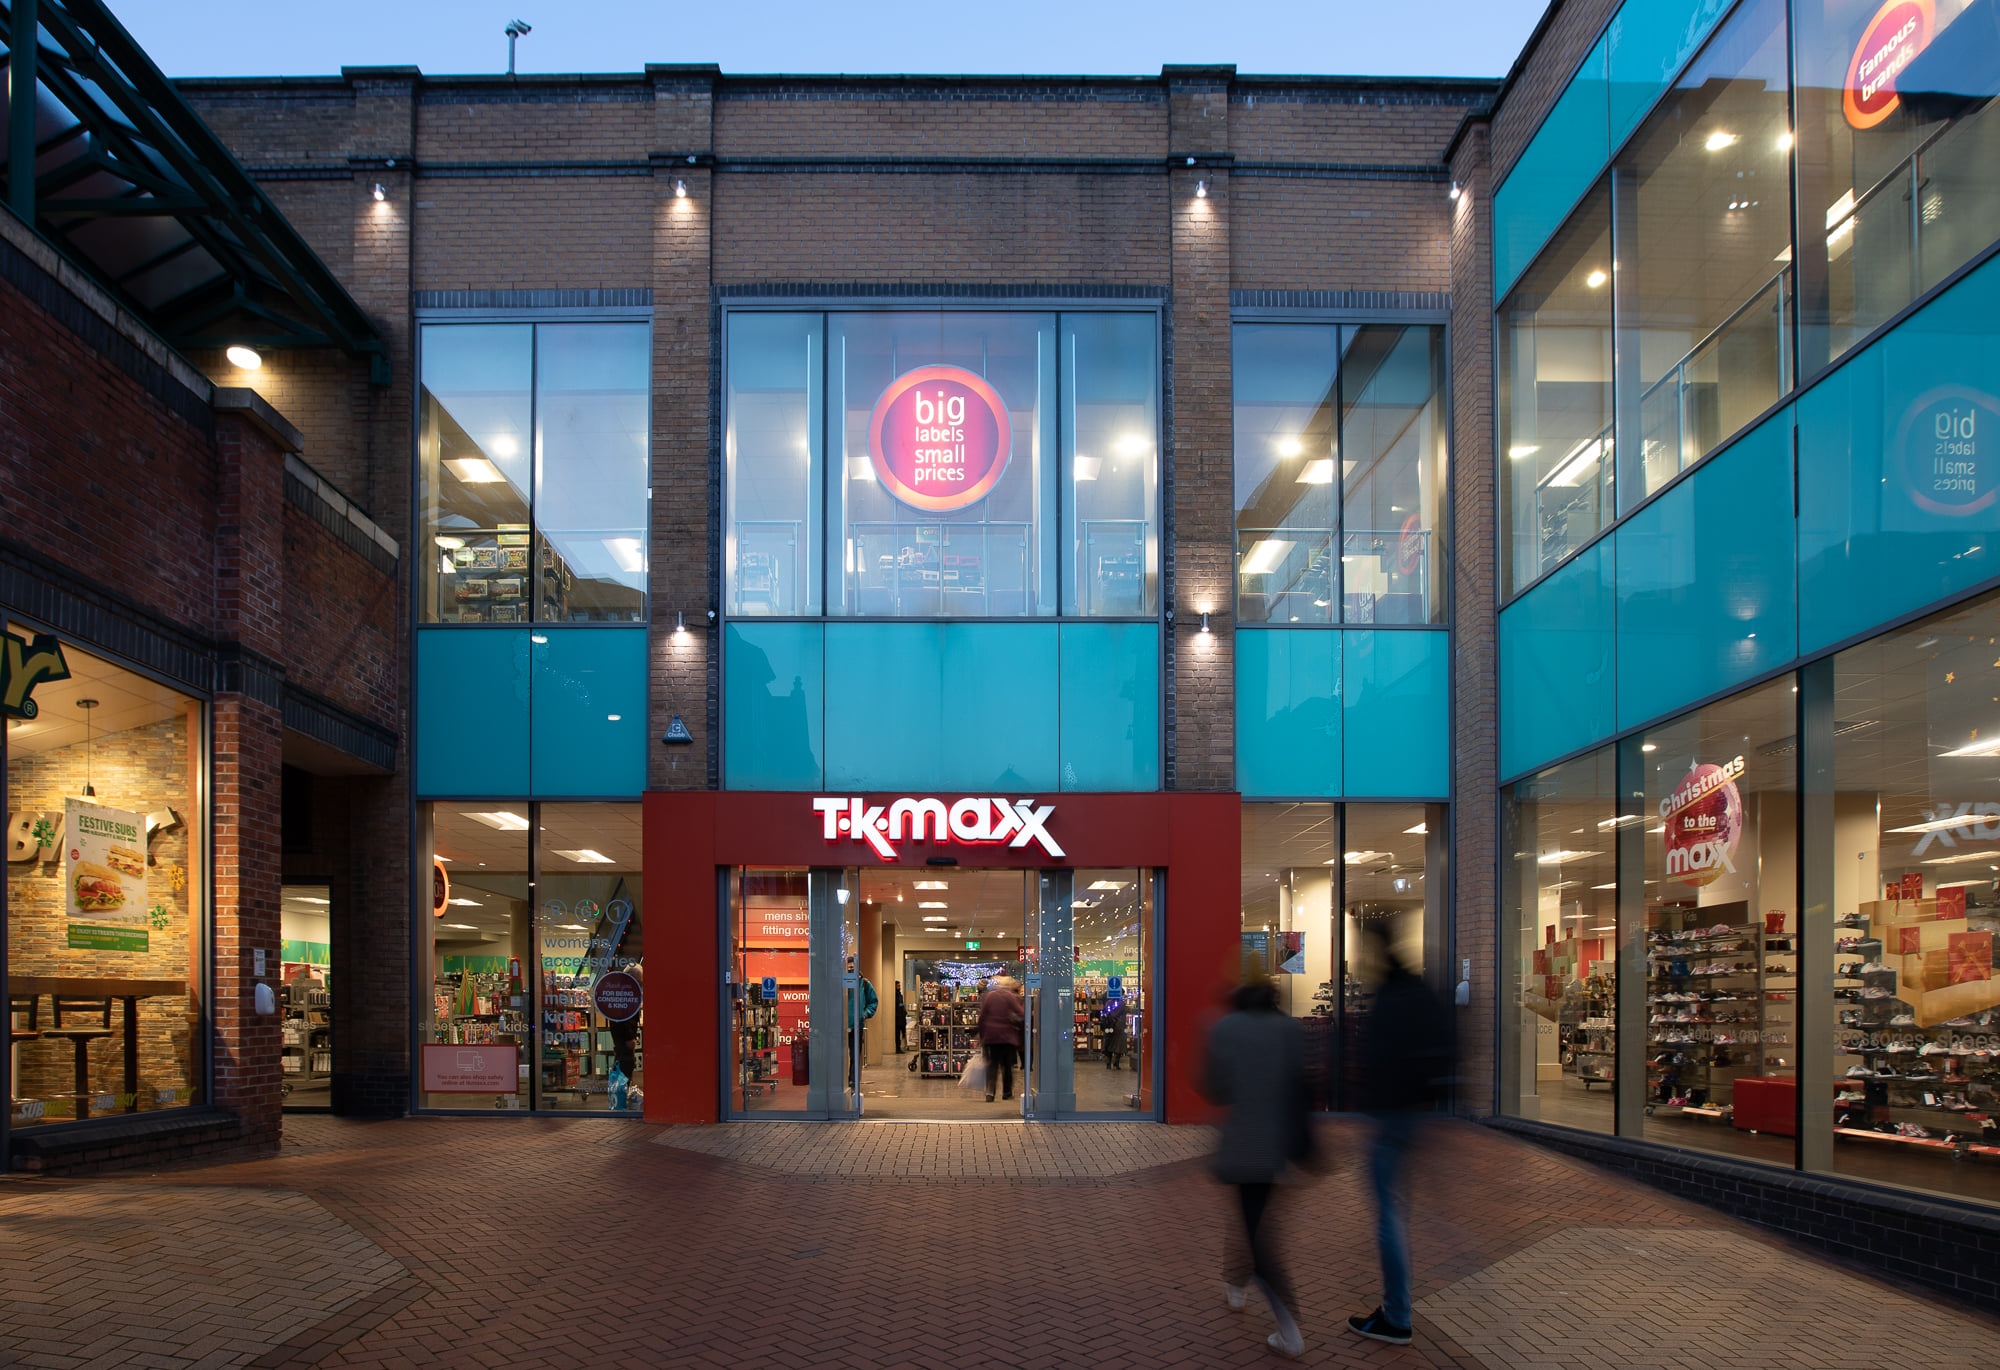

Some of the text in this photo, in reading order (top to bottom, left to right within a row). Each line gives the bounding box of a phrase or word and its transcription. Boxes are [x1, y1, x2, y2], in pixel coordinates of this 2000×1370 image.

[1859, 16, 1916, 82] famous
[1862, 43, 1914, 102] brands
[915, 391, 965, 426] big
[915, 426, 965, 442] labels
[915, 444, 965, 463] small
[914, 464, 965, 485] prices
[1659, 755, 1745, 818] Christmas
[78, 815, 137, 838] FESTIVE SUBS
[1683, 813, 1717, 829] to the
[1665, 838, 1737, 874] maxx
[550, 905, 561, 918] B
[580, 905, 592, 918] G
[764, 913, 793, 921] mens
[762, 925, 792, 937] fitting
[544, 938, 610, 948] womens
[544, 954, 637, 968] accessories
[544, 975, 591, 987] shoes
[544, 993, 587, 1005] mens
[544, 1010, 577, 1024] kids
[503, 1020, 530, 1032] kids
[544, 1030, 588, 1043] home
[92, 1093, 140, 1110] SUBWAY
